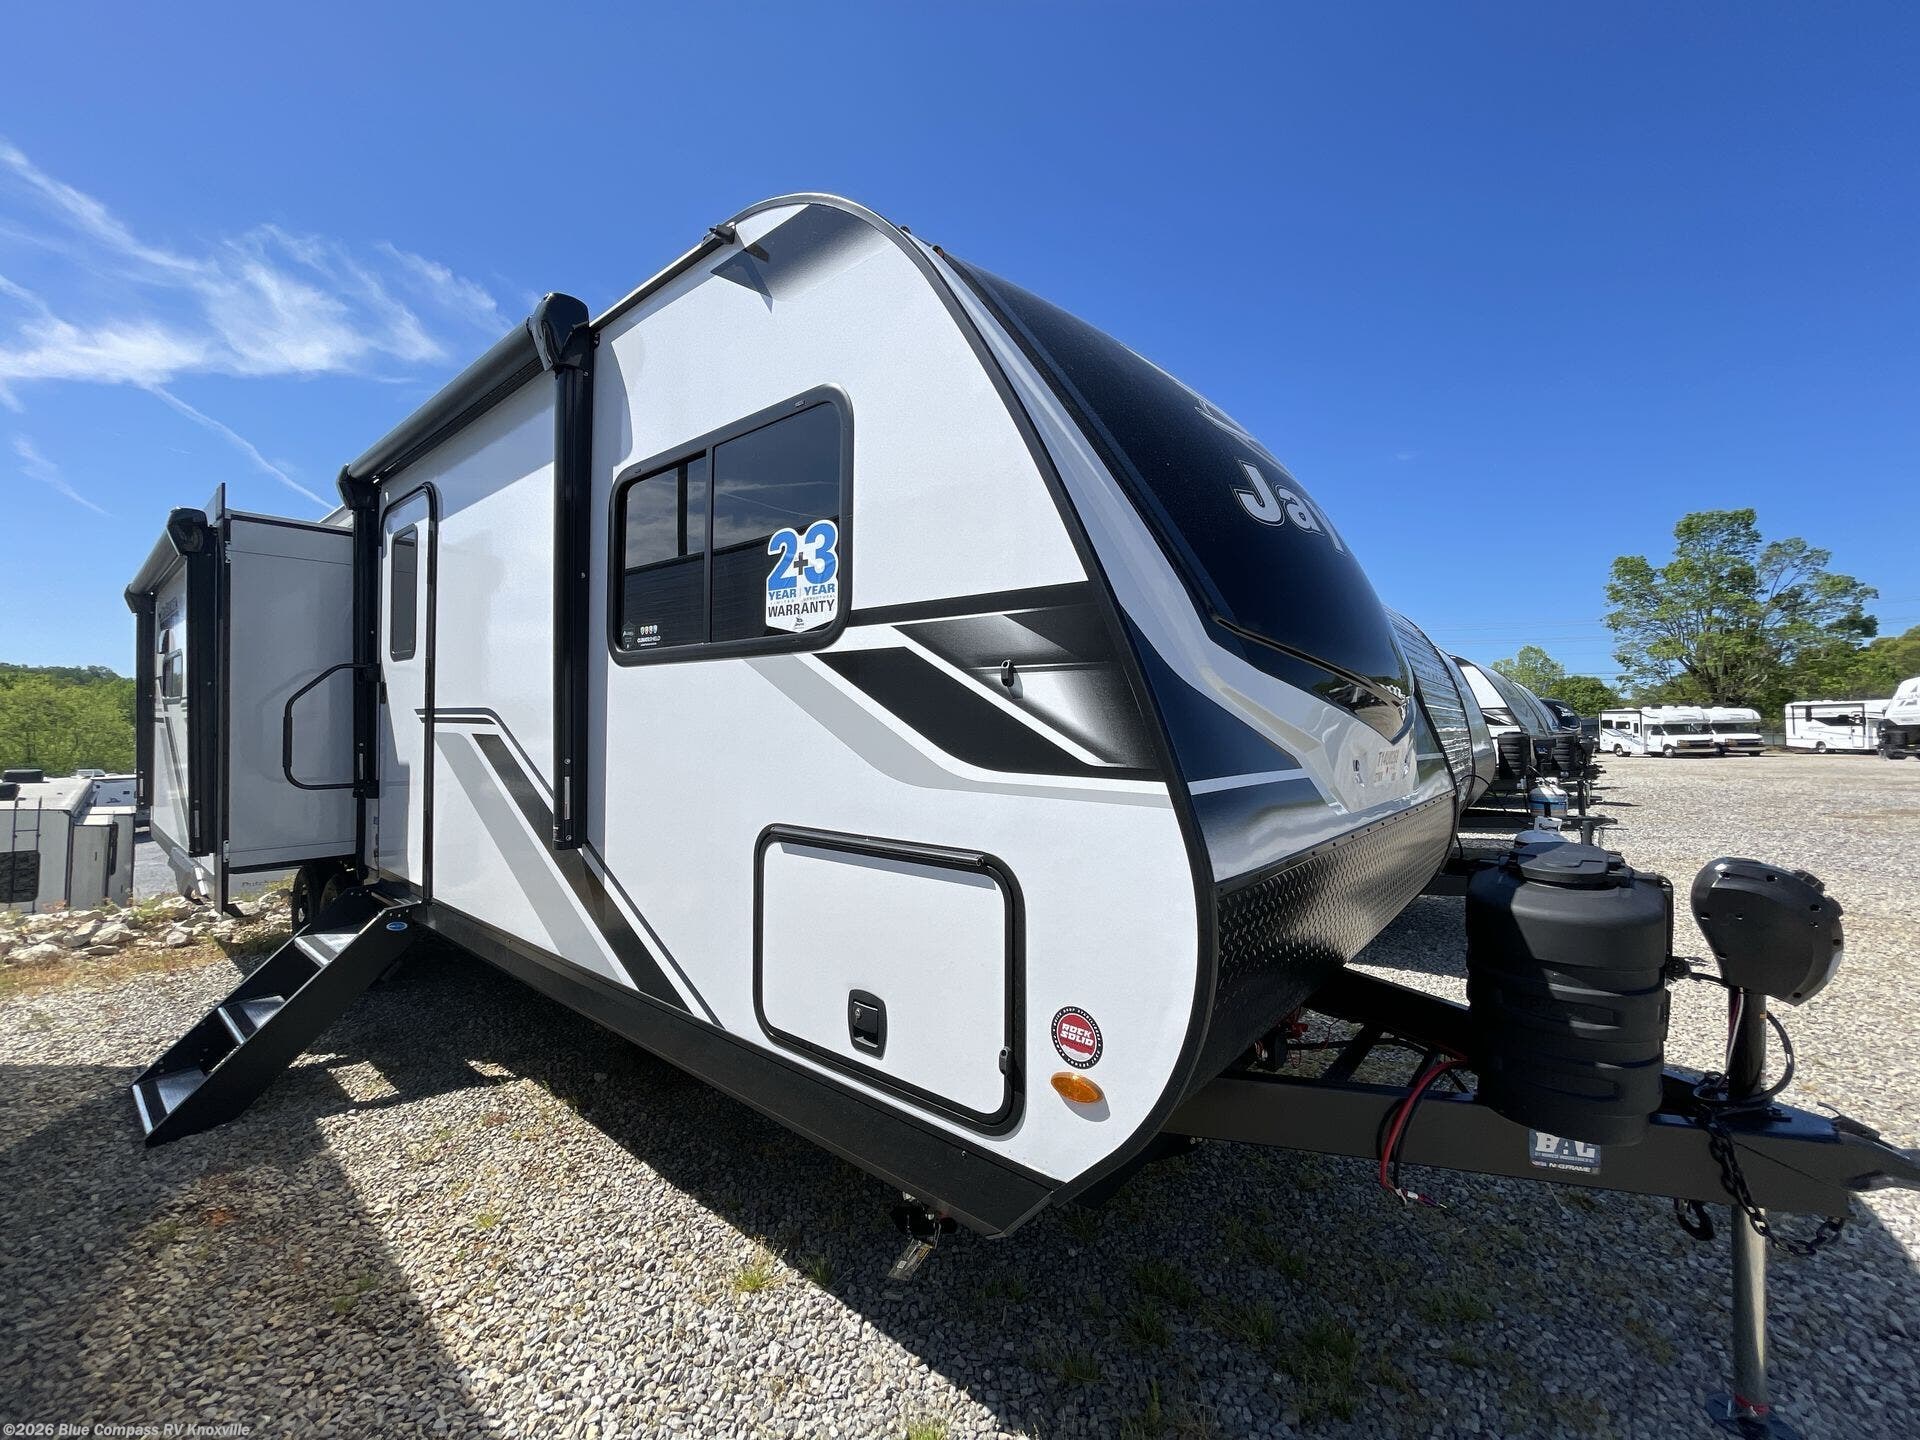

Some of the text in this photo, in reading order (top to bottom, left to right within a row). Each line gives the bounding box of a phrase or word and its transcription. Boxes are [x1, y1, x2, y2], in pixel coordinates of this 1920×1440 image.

[768, 583, 836, 601] YEAR YEAR
[768, 599, 835, 618] WARRANTY
[1060, 1030, 1094, 1046] SOLID
[1062, 1023, 1092, 1038] ROCK
